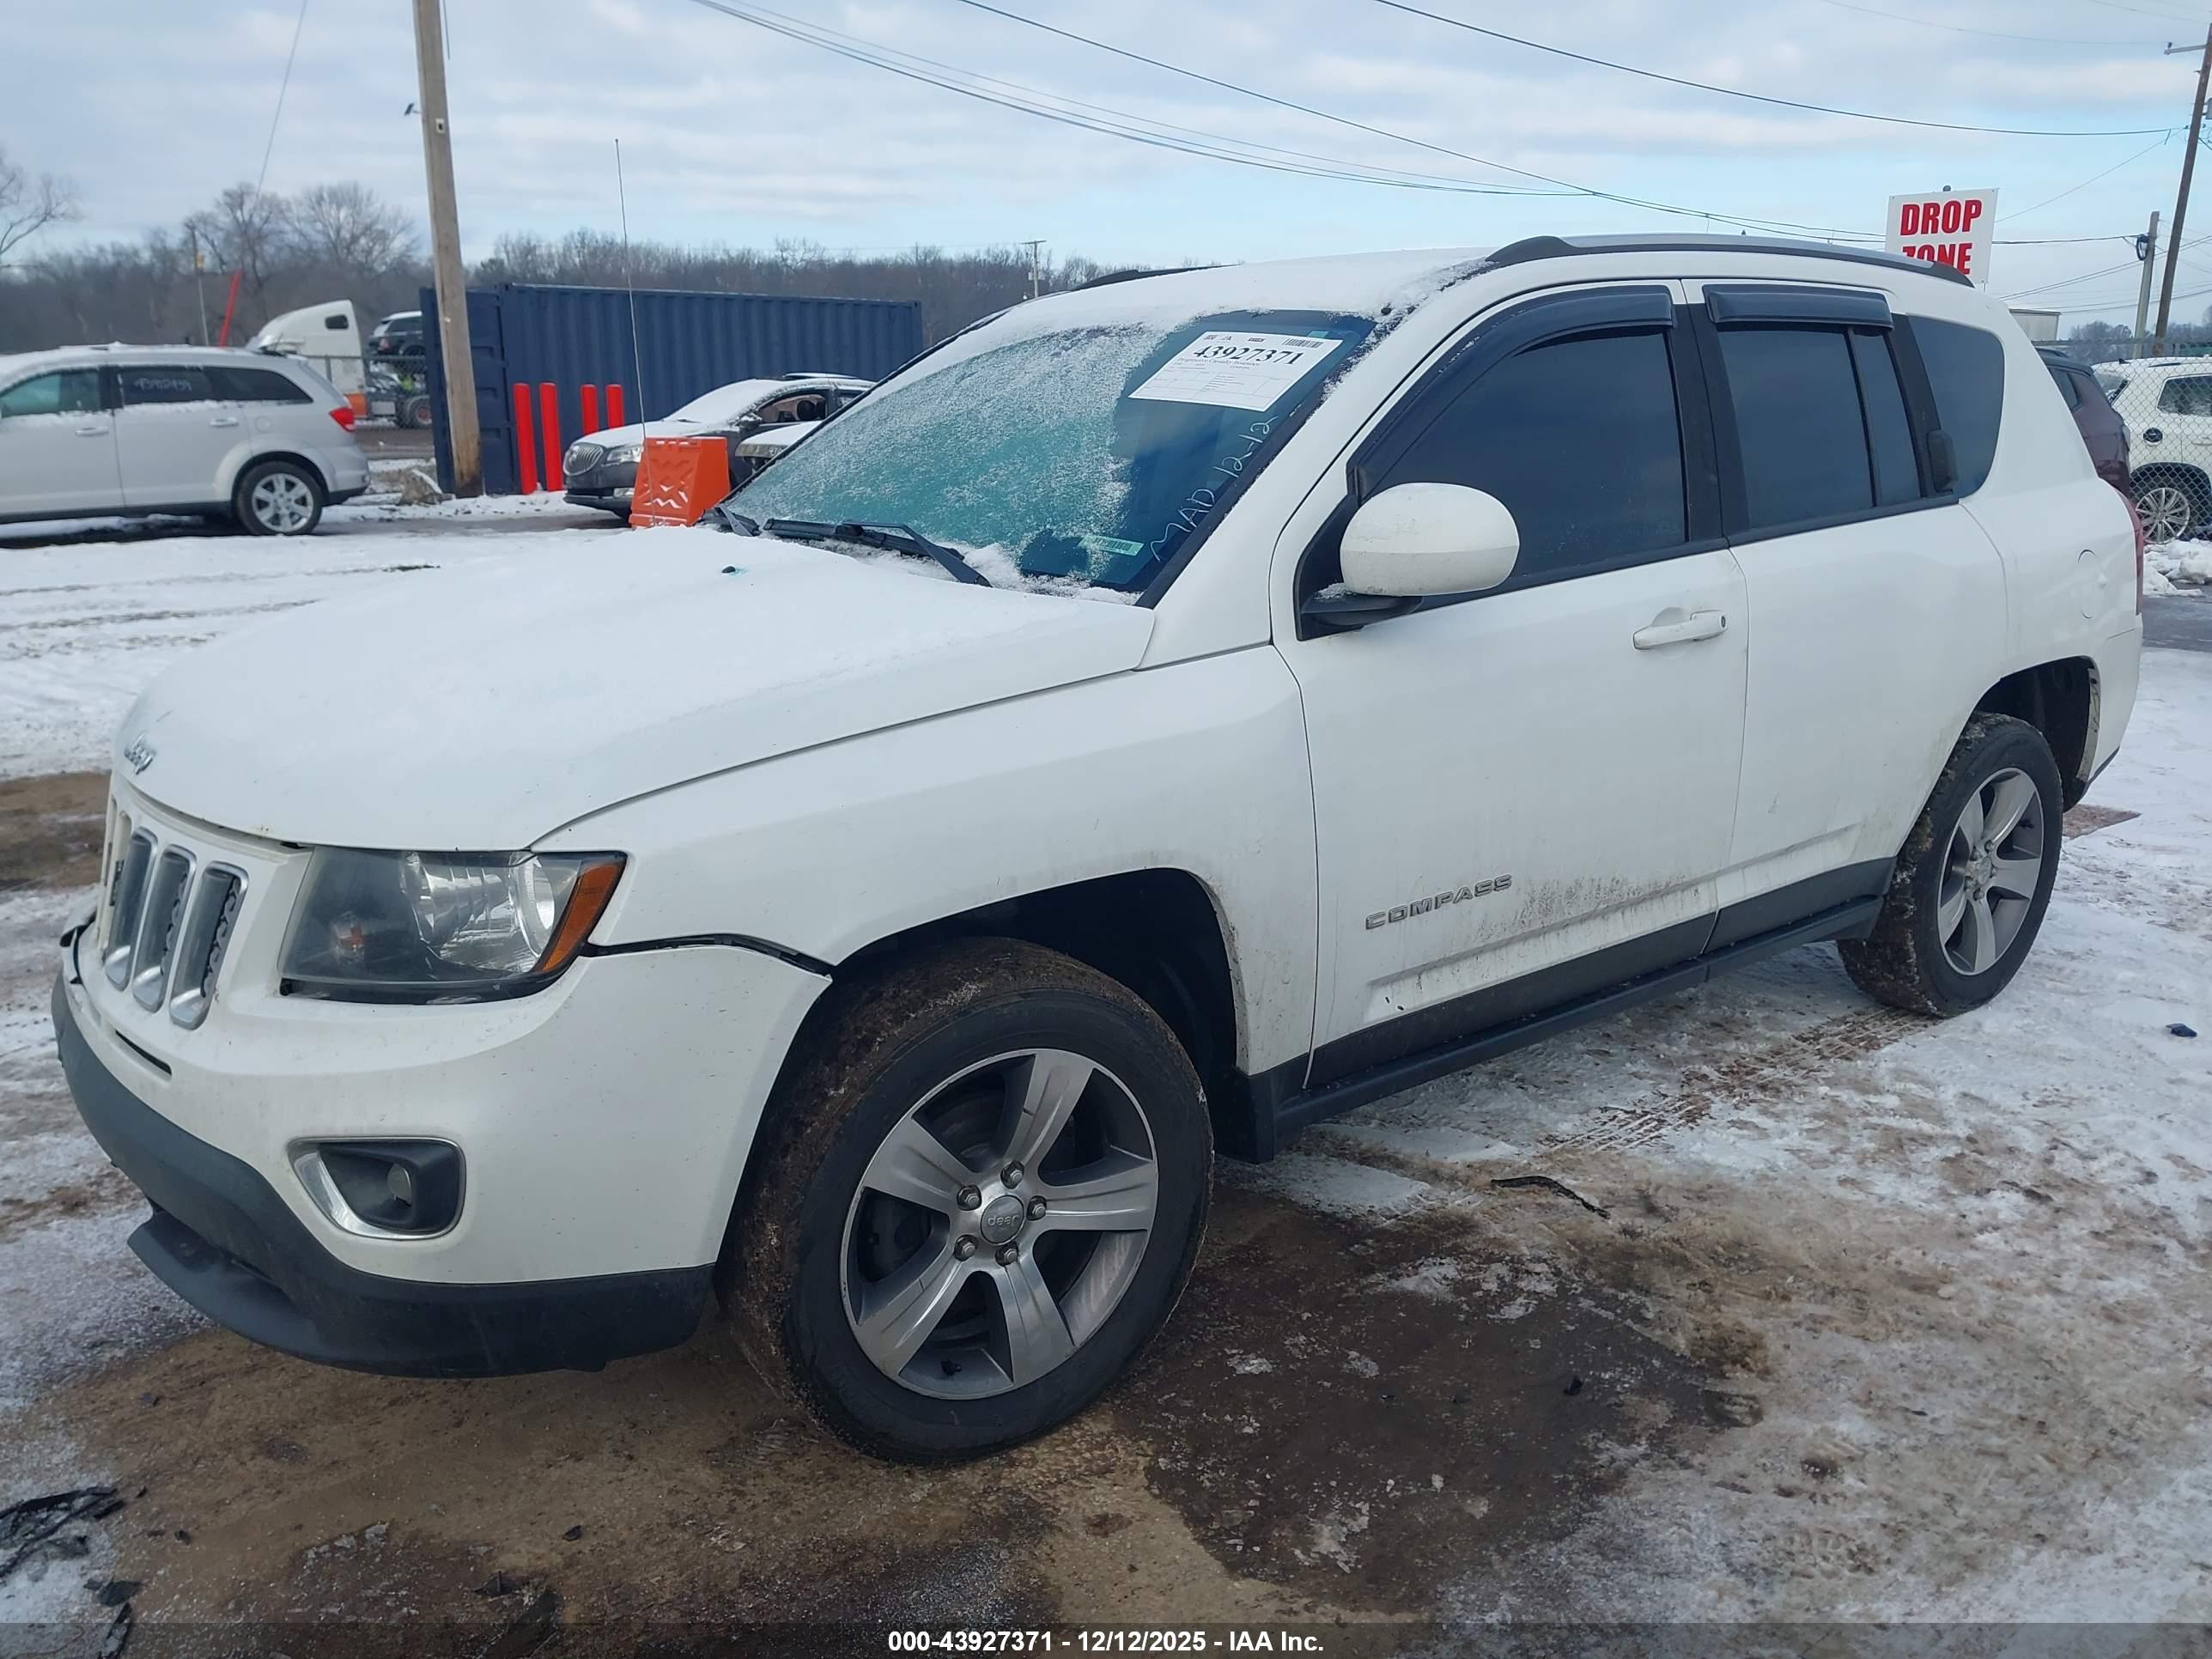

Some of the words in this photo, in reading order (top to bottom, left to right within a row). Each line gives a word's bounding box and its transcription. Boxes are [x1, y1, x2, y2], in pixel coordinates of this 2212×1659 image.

[1900, 199, 1982, 235] DROP
[1193, 344, 1304, 365] 43927371
[1365, 873, 1512, 930] COMPASS
